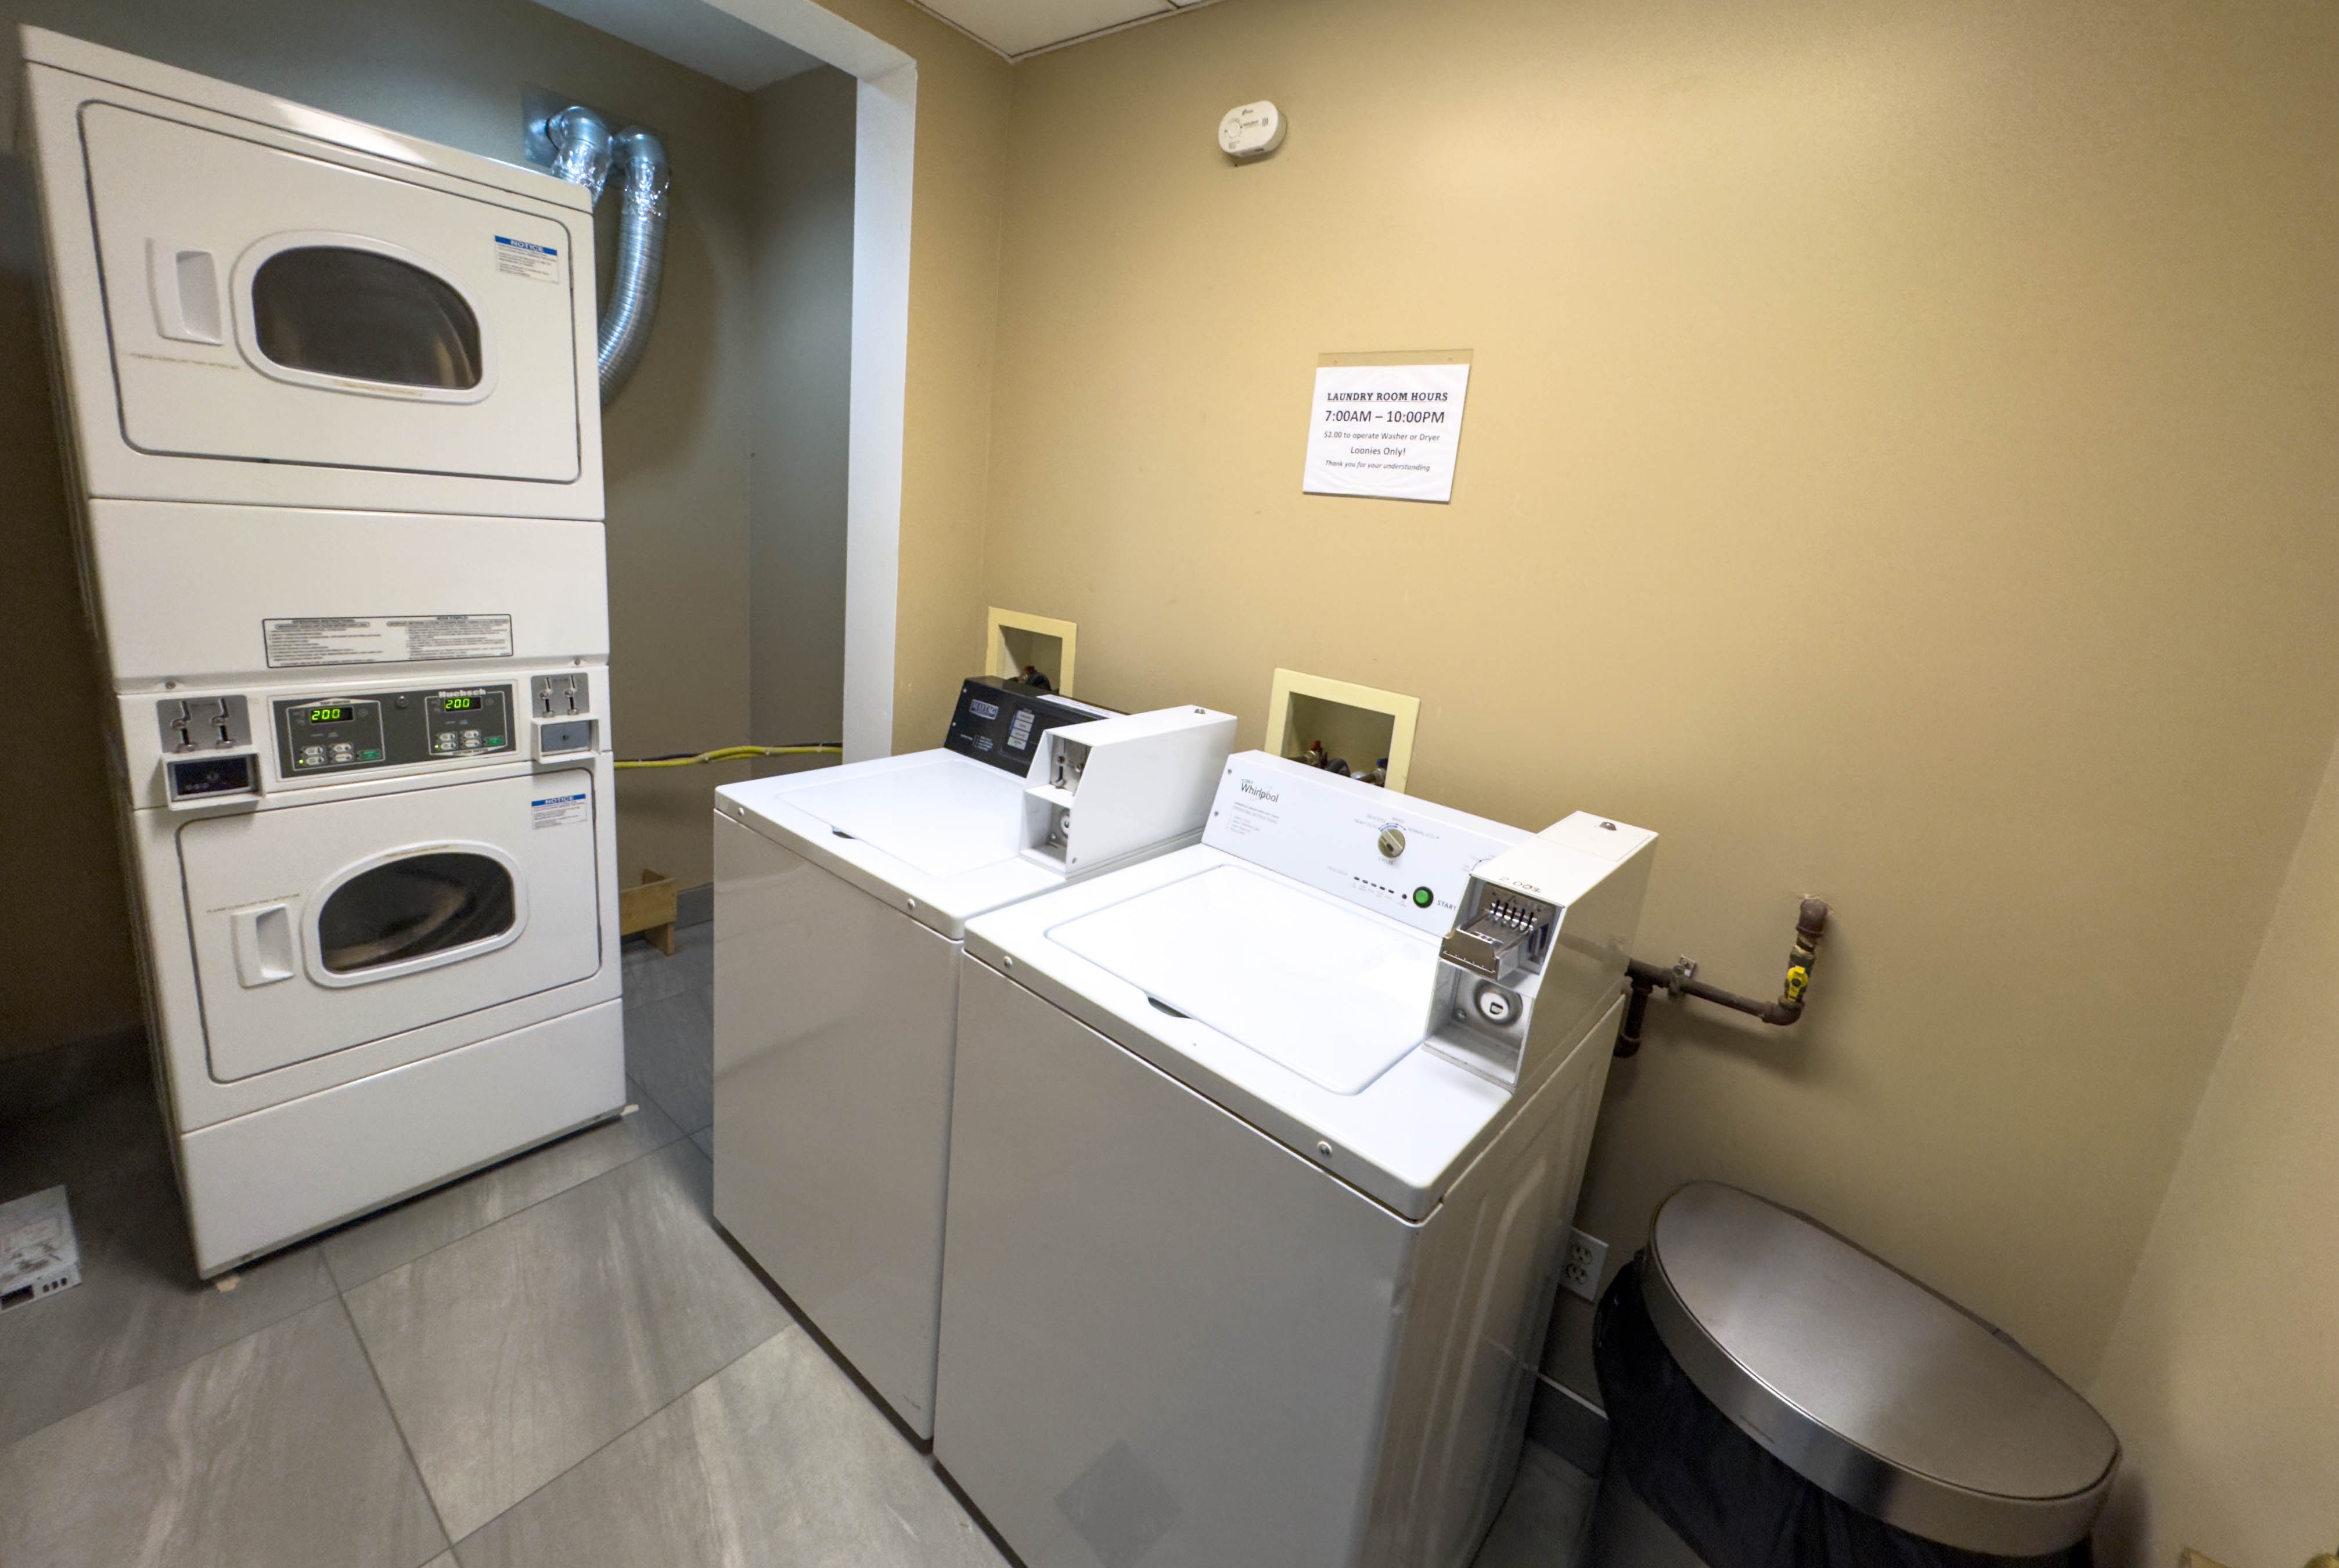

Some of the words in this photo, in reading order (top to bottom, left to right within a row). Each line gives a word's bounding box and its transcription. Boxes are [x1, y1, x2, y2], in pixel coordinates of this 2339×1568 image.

[510, 239, 545, 252] NOTICE
[1327, 393, 1373, 401] LAUNDRY
[1376, 392, 1408, 401] ROOM
[1410, 392, 1448, 401] HOURS
[1325, 411, 1372, 422] 7:00AM
[1386, 411, 1445, 423] 10:00PM
[1350, 446, 1381, 455] Loonies
[1383, 447, 1406, 457] Only!
[1383, 463, 1431, 472] understanding
[445, 698, 470, 709] 200
[311, 709, 341, 721] 200
[1241, 783, 1279, 802] Whirlpool
[545, 796, 574, 804] NOTICE
